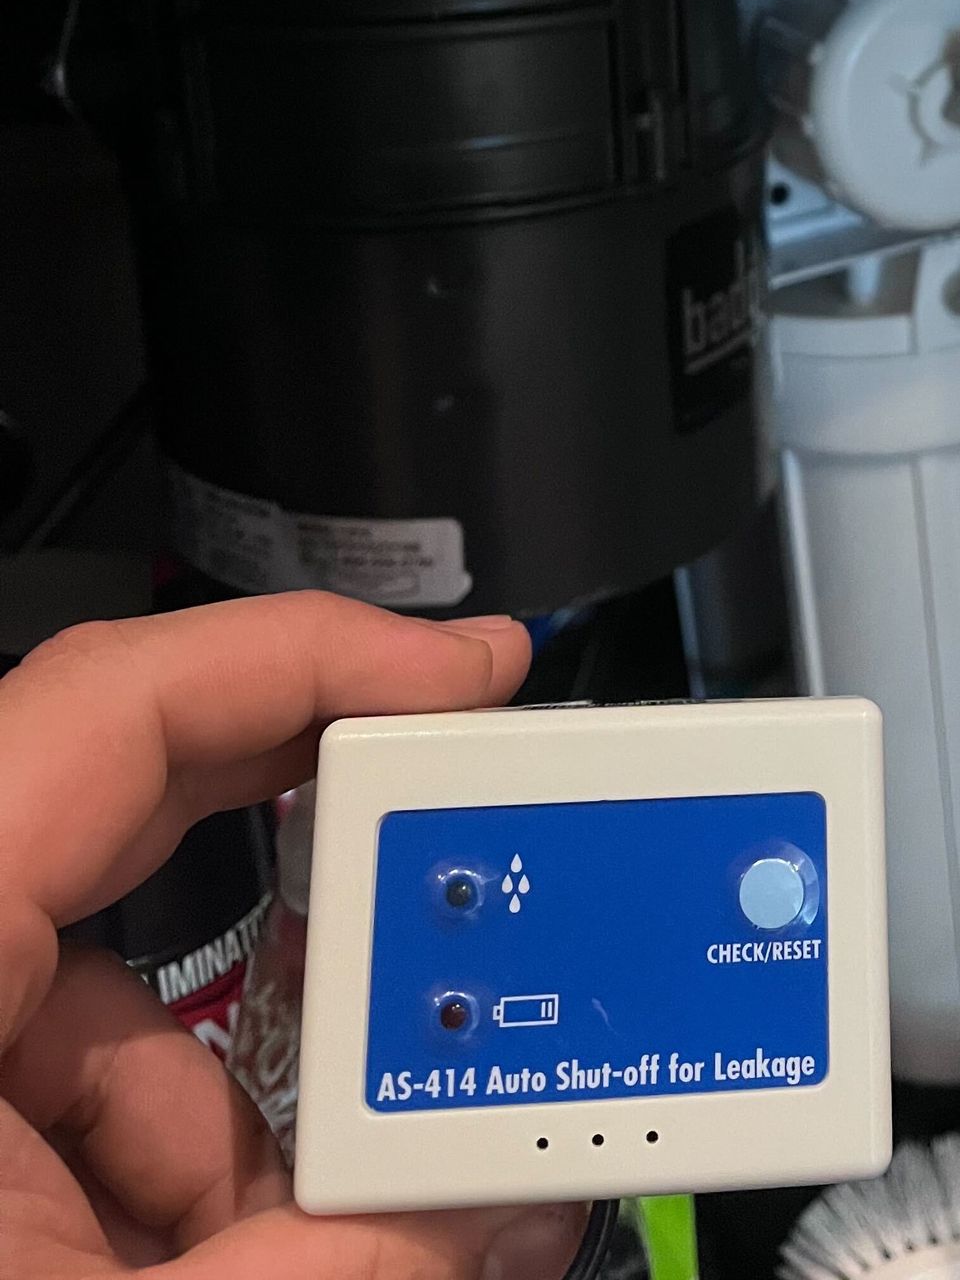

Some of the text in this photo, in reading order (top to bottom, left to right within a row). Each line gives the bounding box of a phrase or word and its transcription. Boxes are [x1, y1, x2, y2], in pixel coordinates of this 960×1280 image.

[707, 939, 822, 964] CHECK/RESET
[376, 1048, 815, 1102] AS-414 Auto Shut-off for Leakage
